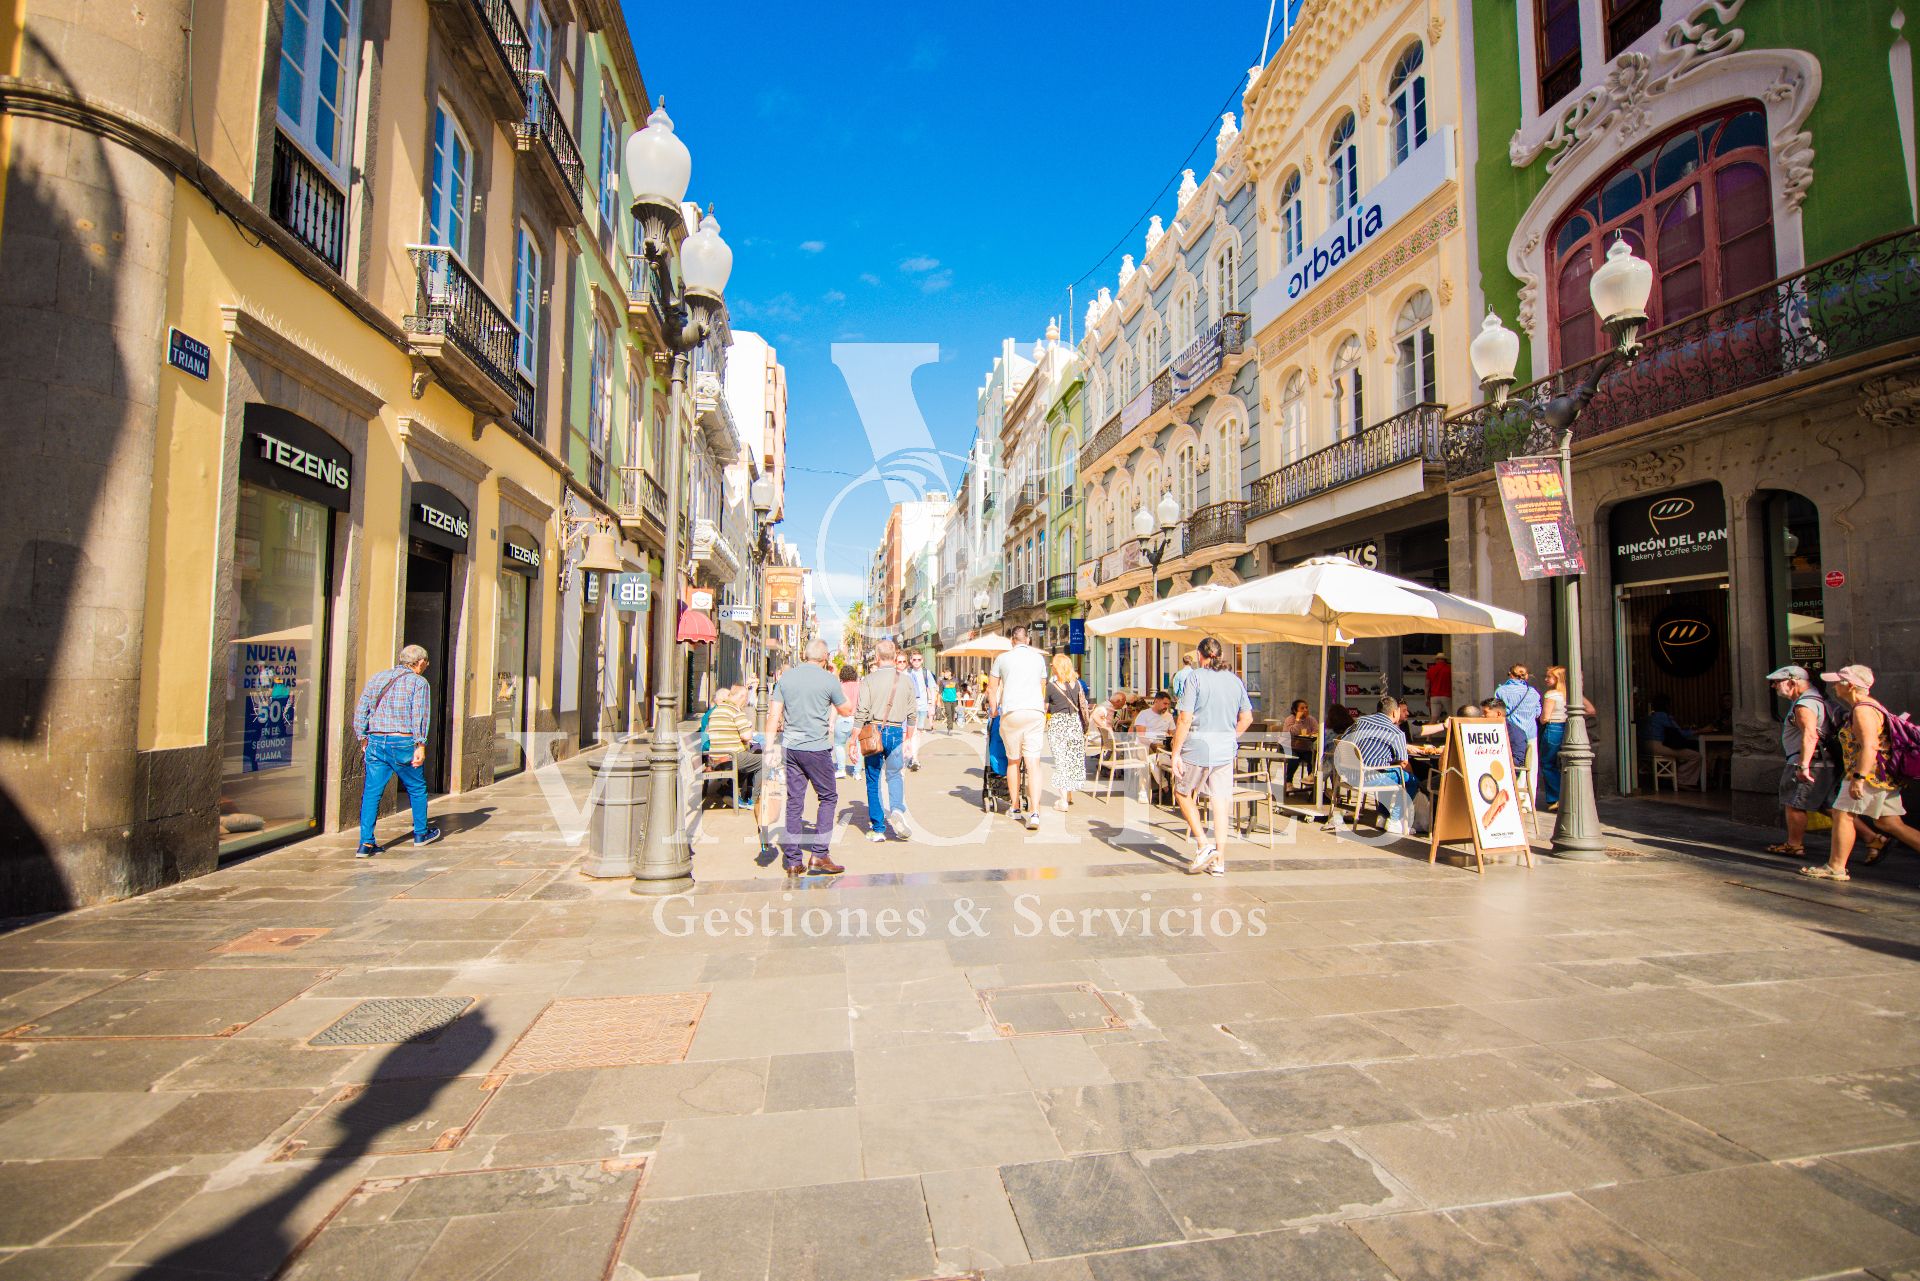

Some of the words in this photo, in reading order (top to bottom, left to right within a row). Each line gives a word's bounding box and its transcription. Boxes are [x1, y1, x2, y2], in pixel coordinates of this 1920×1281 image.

[1287, 204, 1383, 299] orbalia
[184, 339, 209, 359] CALLE
[172, 346, 206, 377] TRIANA
[1617, 537, 1666, 555] RINCÓN
[1669, 534, 1695, 548] DEL
[1697, 528, 1728, 543] PAN
[1631, 552, 1655, 562] Bakery
[1664, 546, 1690, 556] Coffee
[1692, 544, 1713, 553] Shop
[246, 644, 296, 661] NUEVA
[243, 678, 256, 689] DE
[251, 738, 286, 750] SEGUNDO
[1468, 728, 1499, 744] MENÚ
[255, 750, 282, 762] PIJAMA
